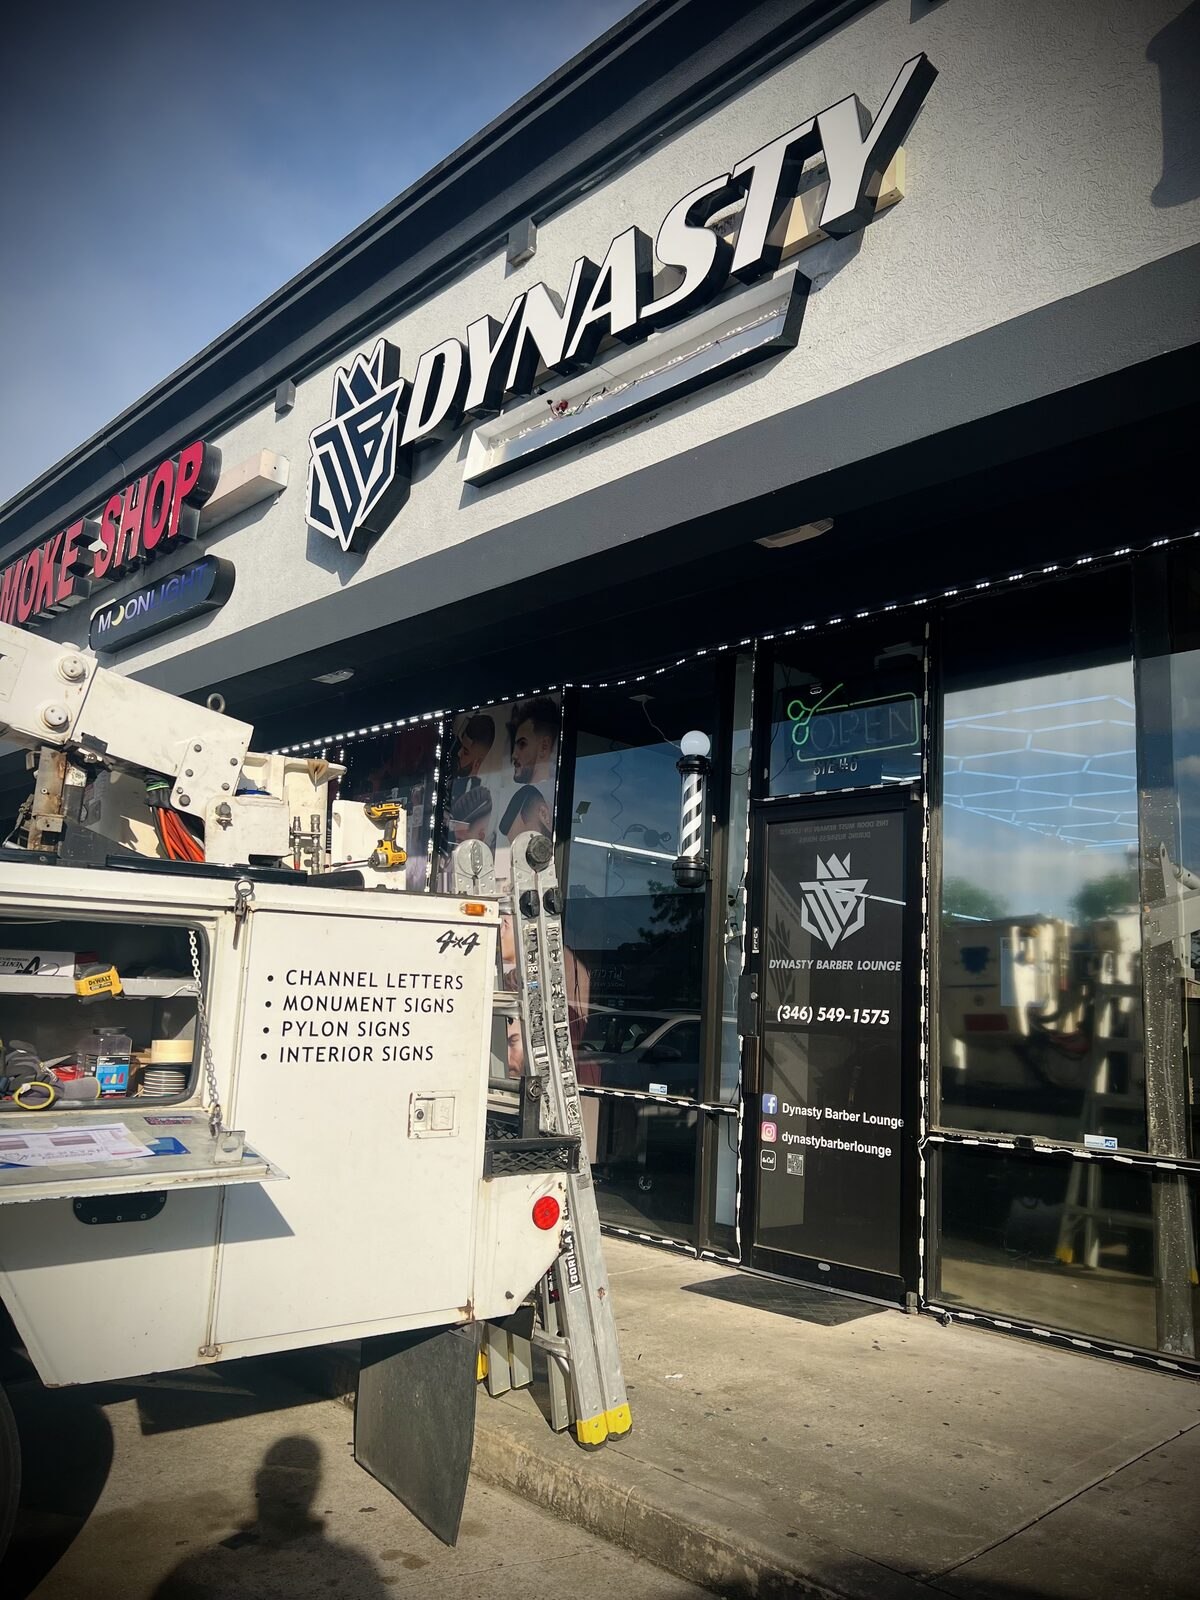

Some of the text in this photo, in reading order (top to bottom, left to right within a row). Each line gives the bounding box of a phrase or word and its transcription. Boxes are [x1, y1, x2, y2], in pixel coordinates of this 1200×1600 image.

[401, 52, 935, 448] DYNASTY
[93, 440, 204, 578] SHOP
[97, 562, 208, 633] MOONLIGHT
[810, 702, 915, 752] OPEN
[436, 929, 481, 956] 4x4
[769, 959, 902, 972] DYNASTY BARBER LOUNGE
[285, 969, 464, 991] CHANNEL LETTERS
[282, 996, 455, 1014] MONUMENT SIGNS
[777, 1004, 890, 1025] (346) 549-1575
[281, 1021, 411, 1038] PYLON SIGNS
[279, 1045, 434, 1063] INTERIOR SIGNS
[782, 1102, 905, 1130] Dynasty Barber Lounge
[781, 1132, 892, 1157] dynastybarberlounge
